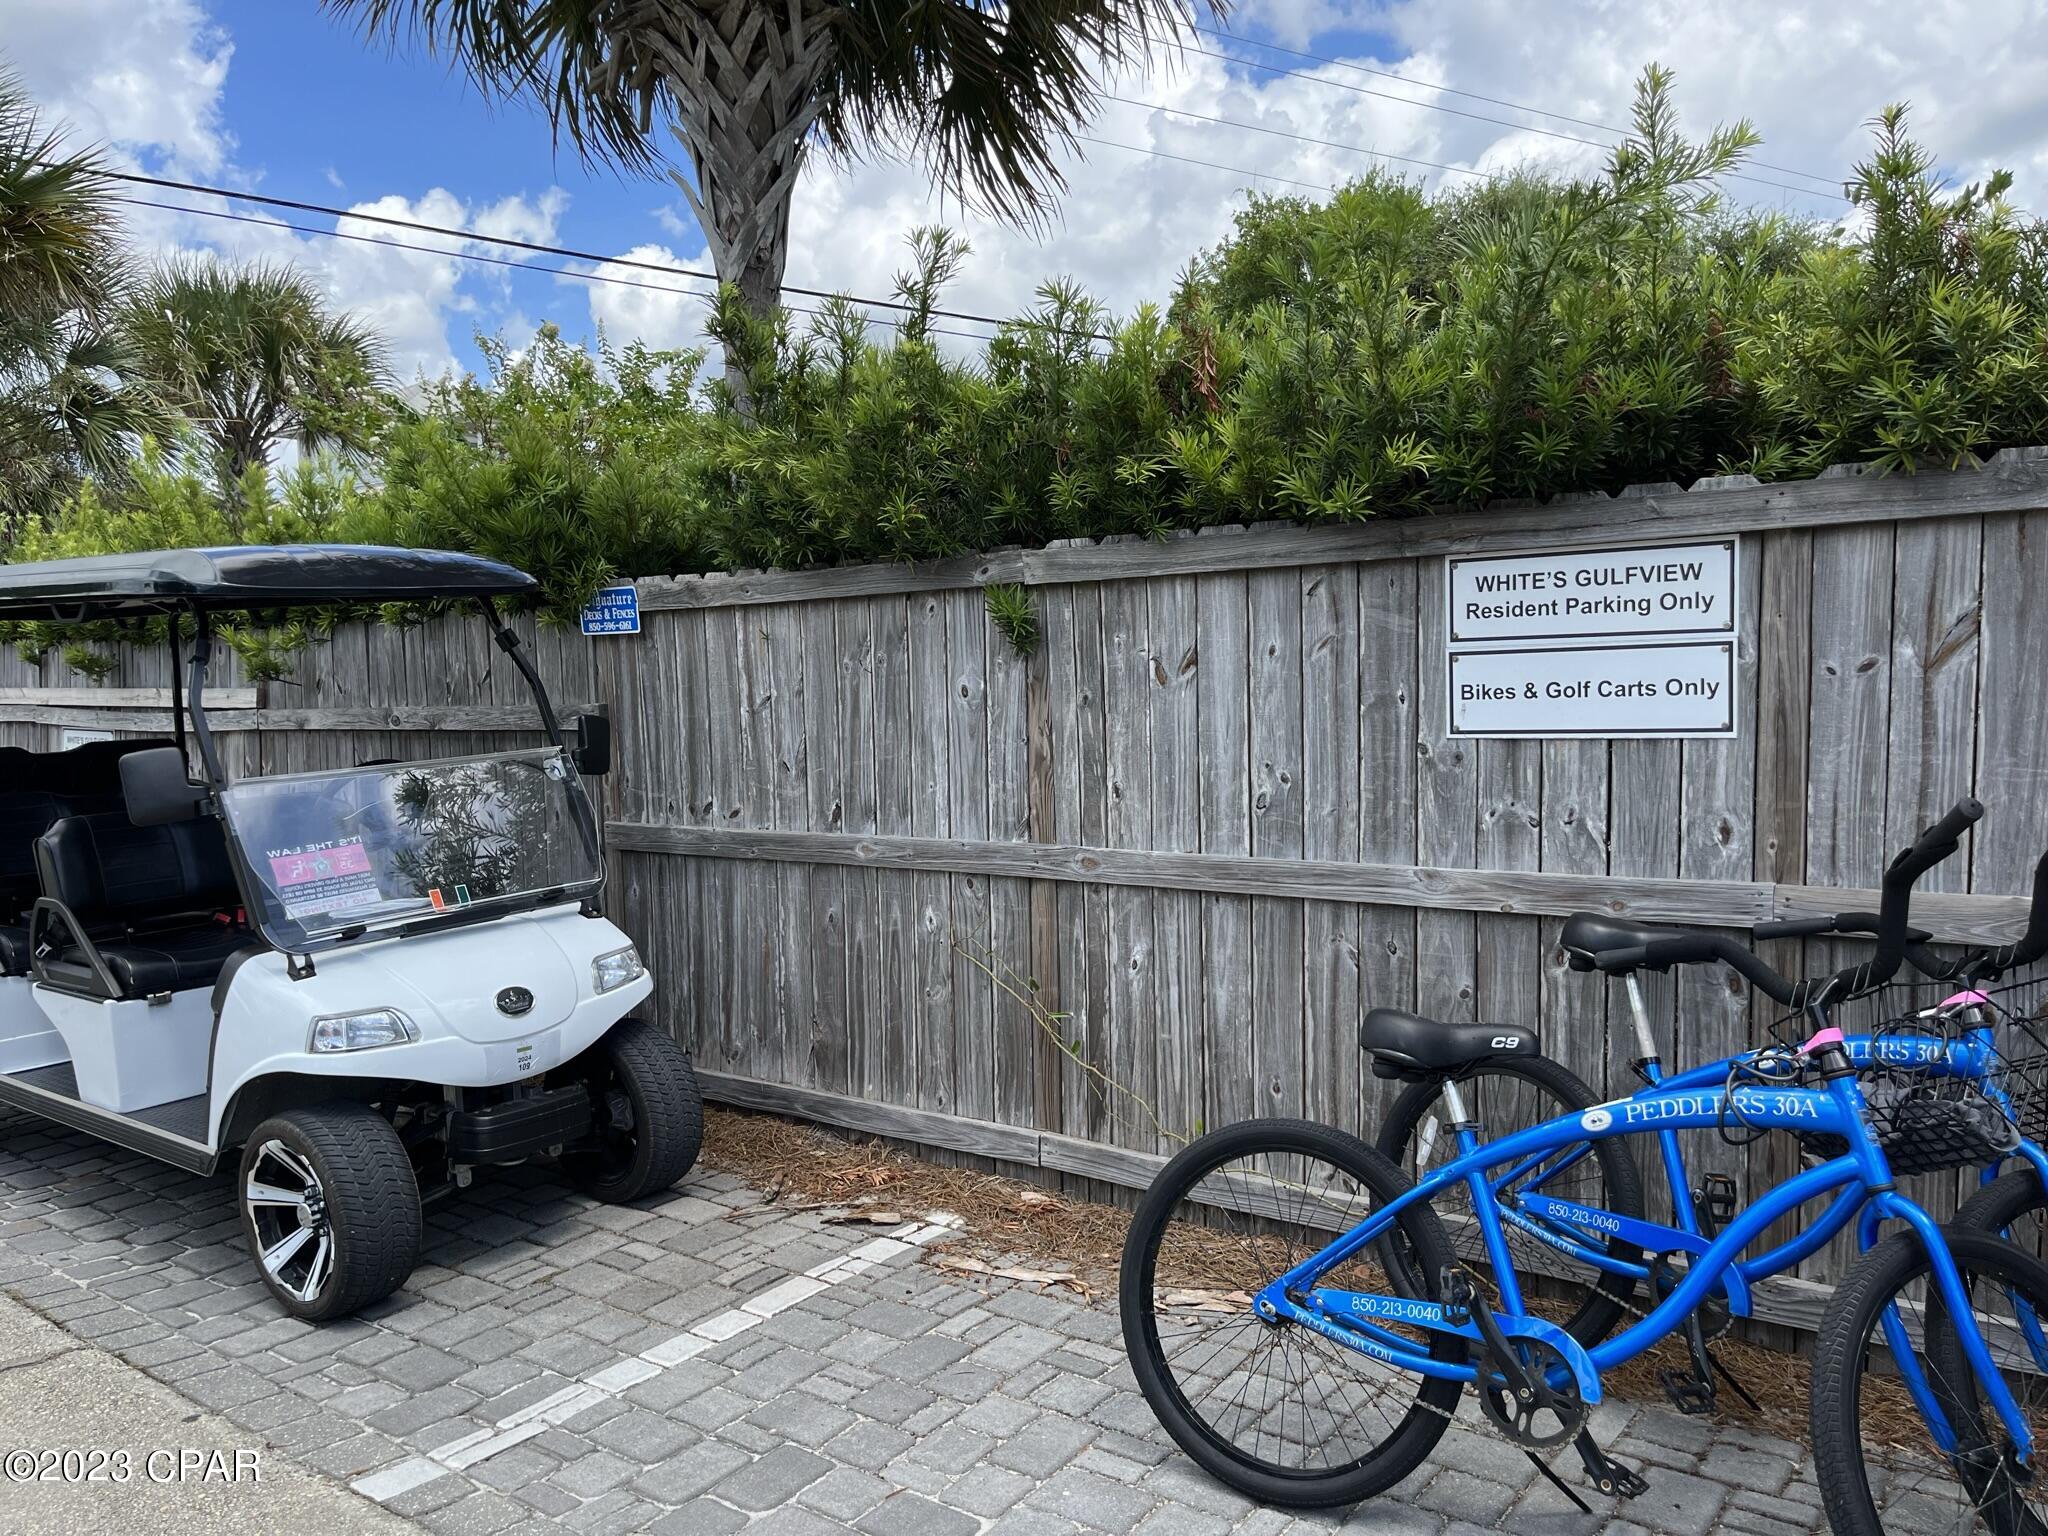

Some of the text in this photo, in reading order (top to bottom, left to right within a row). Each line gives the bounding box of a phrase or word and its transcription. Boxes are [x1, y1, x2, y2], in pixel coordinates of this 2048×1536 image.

[1475, 562, 1703, 593] WHITE'S GULFVIEW
[586, 593, 632, 609] ignature
[1466, 591, 1714, 619] Resident Parking Only
[604, 608, 611, 619] &
[1461, 678, 1720, 700] Bikes & Golf Carts Only
[1491, 1037, 1519, 1048] C9
[1772, 1096, 1818, 1118] 30A
[1548, 1202, 1620, 1232] 850-213-0040
[1351, 1296, 1441, 1322] 850-213-0040
